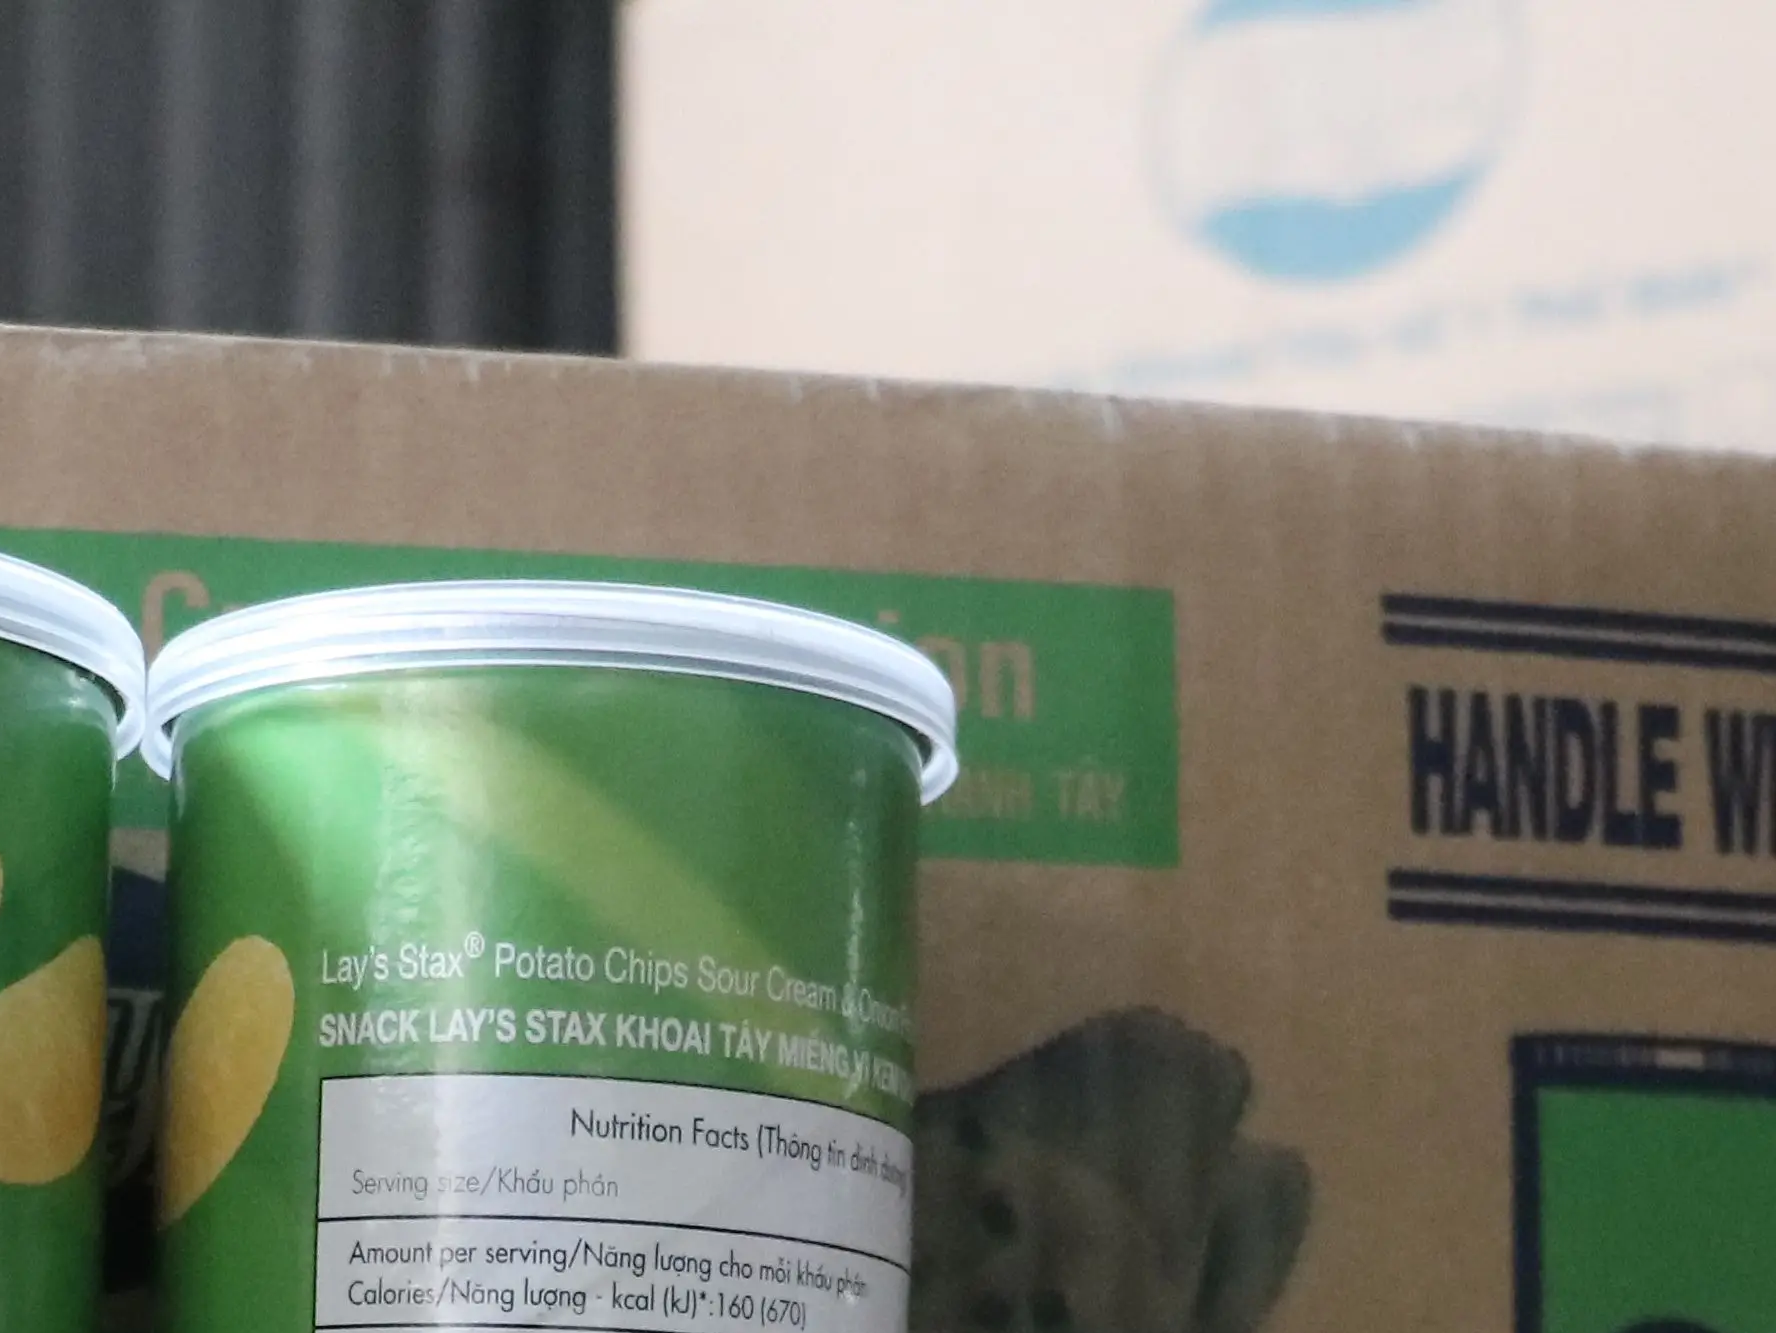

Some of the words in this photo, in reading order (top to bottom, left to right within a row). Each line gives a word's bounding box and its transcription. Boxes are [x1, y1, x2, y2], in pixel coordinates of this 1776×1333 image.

[1407, 685, 1683, 852] HANDLE
[322, 945, 390, 991] Lay's
[494, 942, 595, 982] Potato
[605, 947, 688, 994] Chips
[697, 955, 760, 996] Sour
[766, 965, 837, 1010] Cream
[319, 1009, 421, 1047] SNACK
[429, 1008, 517, 1043] LAY'S
[525, 1010, 608, 1047] STAX
[616, 1013, 711, 1055] KHOAI
[719, 1018, 771, 1063] TÂY
[571, 1107, 682, 1145] Nutrition
[692, 1116, 750, 1152] Facts
[757, 1124, 821, 1171] (Thông
[827, 1138, 845, 1169] tin
[352, 1168, 428, 1201] Serving
[349, 1240, 432, 1265] Amount
[439, 1246, 477, 1271] per
[654, 1243, 711, 1282] lượng
[719, 1250, 753, 1280] cho
[348, 1276, 515, 1313] Calories/Năng
[523, 1277, 587, 1315] lượng
[612, 1281, 655, 1312] kcal
[761, 1295, 807, 1331] (670)
